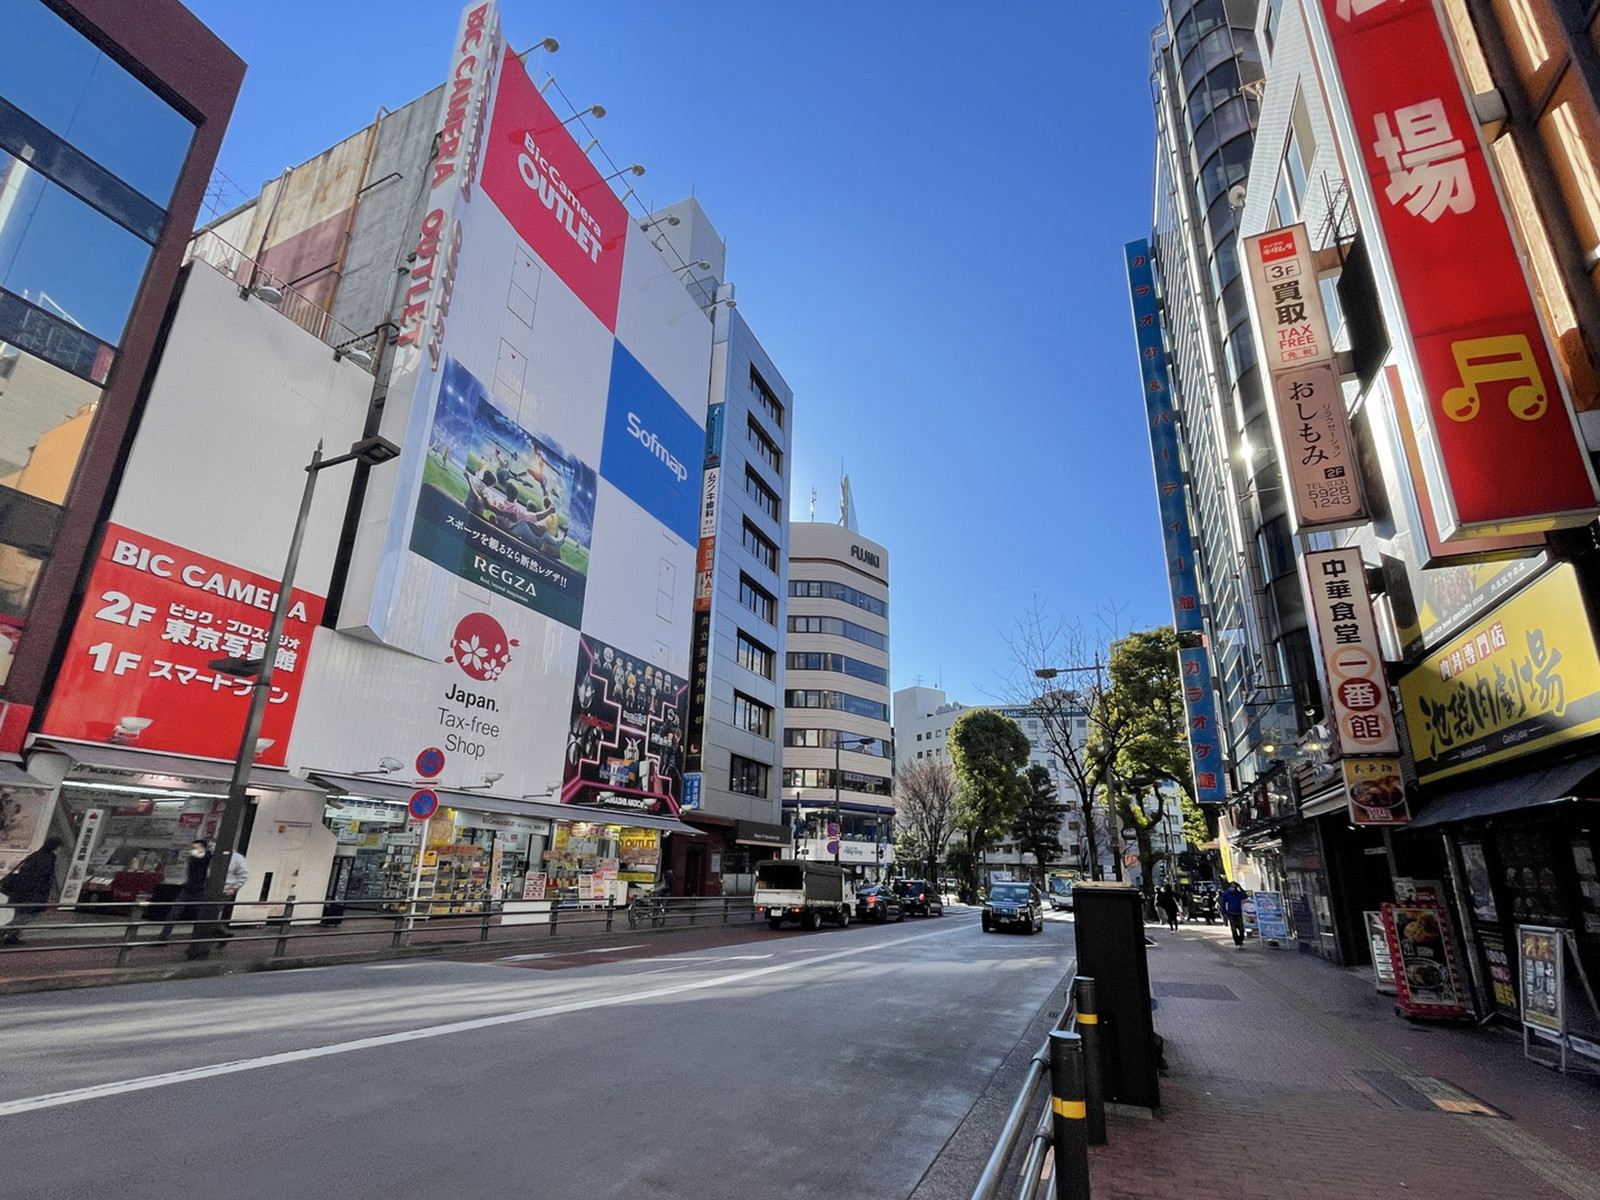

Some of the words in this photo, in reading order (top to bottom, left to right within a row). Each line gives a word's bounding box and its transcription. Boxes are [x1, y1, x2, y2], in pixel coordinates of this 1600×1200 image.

[431, 55, 476, 188] CAMERA
[524, 132, 602, 237] BicCamera
[517, 153, 602, 264] OUTLET
[397, 208, 446, 348] OUTLET
[1271, 265, 1295, 279] 3F
[1272, 280, 1308, 325] 買取
[1277, 324, 1313, 341] TAX
[1279, 334, 1316, 350] FREE
[1289, 381, 1329, 466] おしもみ
[1322, 403, 1341, 458] リラクゼーション
[627, 411, 687, 482] Sofmap
[1326, 467, 1343, 478] 2F
[1309, 485, 1349, 500] 5928
[1312, 496, 1351, 509] 1243
[112, 540, 174, 577] BIC
[474, 554, 537, 597] REGZA
[94, 590, 157, 627] 2F
[88, 642, 143, 676] 1F
[1440, 621, 1507, 680] 肉丼専門店
[149, 659, 289, 704] スマートフン
[445, 684, 500, 713] Japan.
[438, 707, 500, 738] Tax-free
[1184, 661, 1216, 790] カラオケ館
[445, 734, 485, 760] Shop
[625, 838, 656, 849] OUTLET
